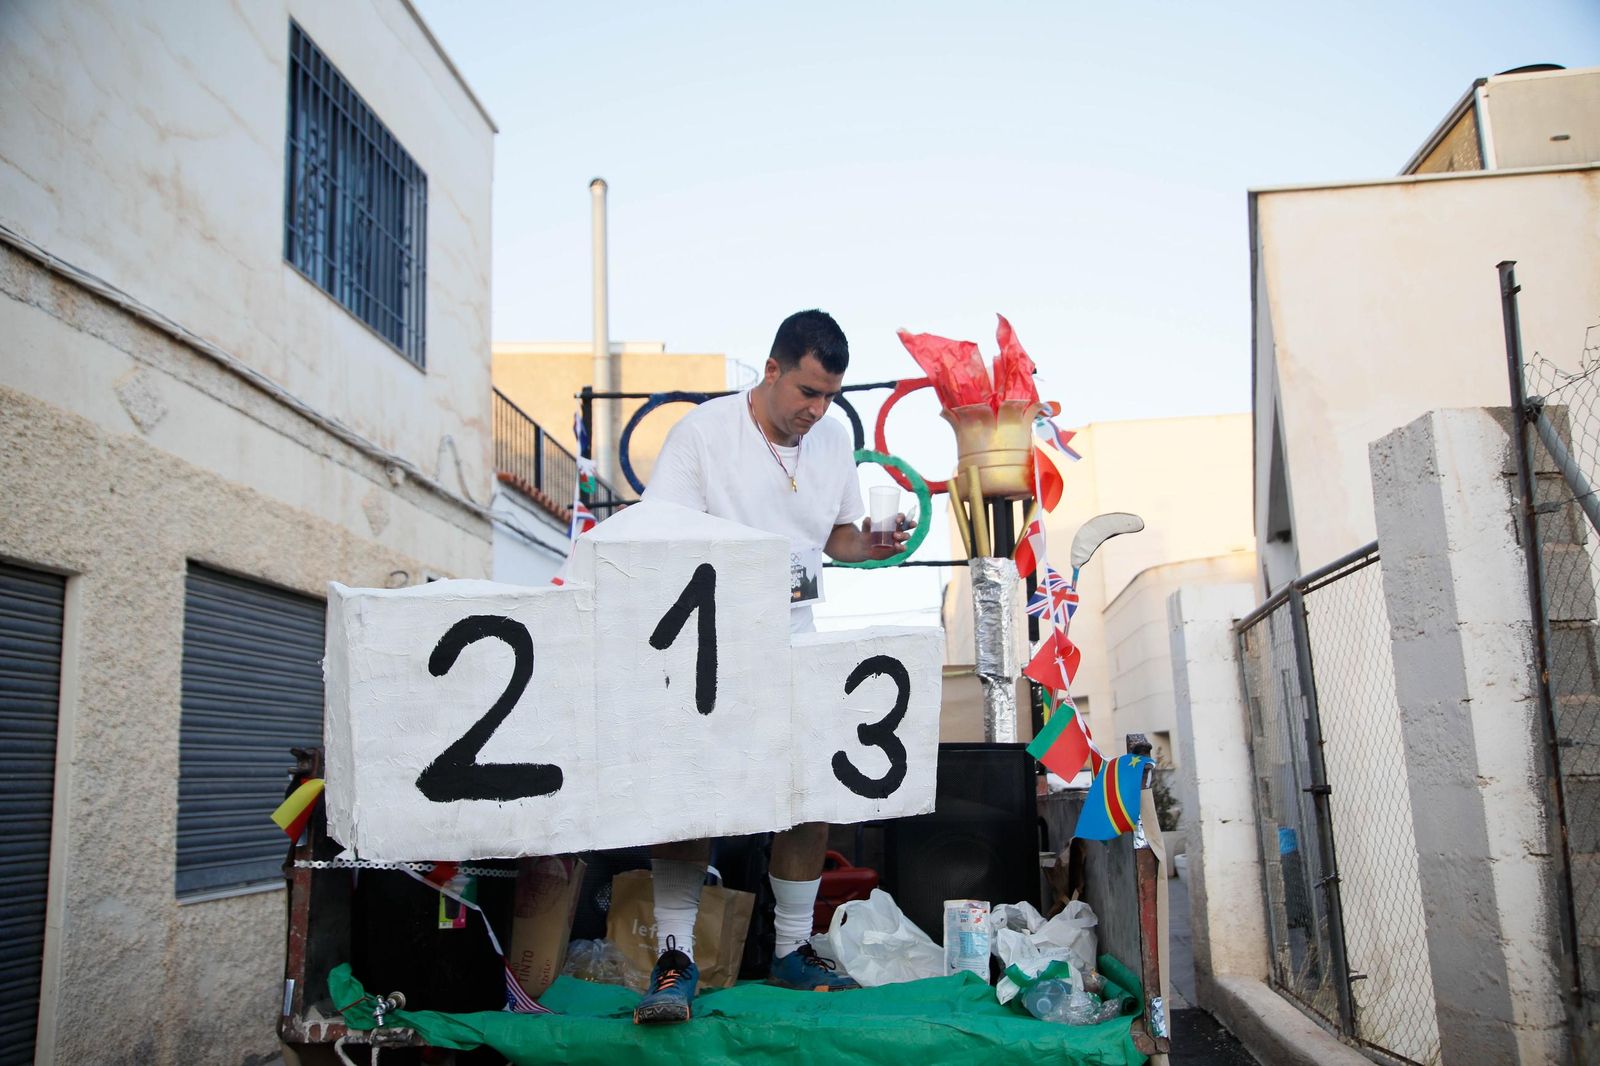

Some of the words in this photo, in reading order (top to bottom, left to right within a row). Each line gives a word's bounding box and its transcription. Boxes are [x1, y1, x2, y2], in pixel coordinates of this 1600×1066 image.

[414, 614, 564, 804] 2
[649, 563, 718, 715] 1
[831, 654, 911, 800] 3
[519, 950, 534, 982] TINTO
[631, 918, 658, 939] lef
